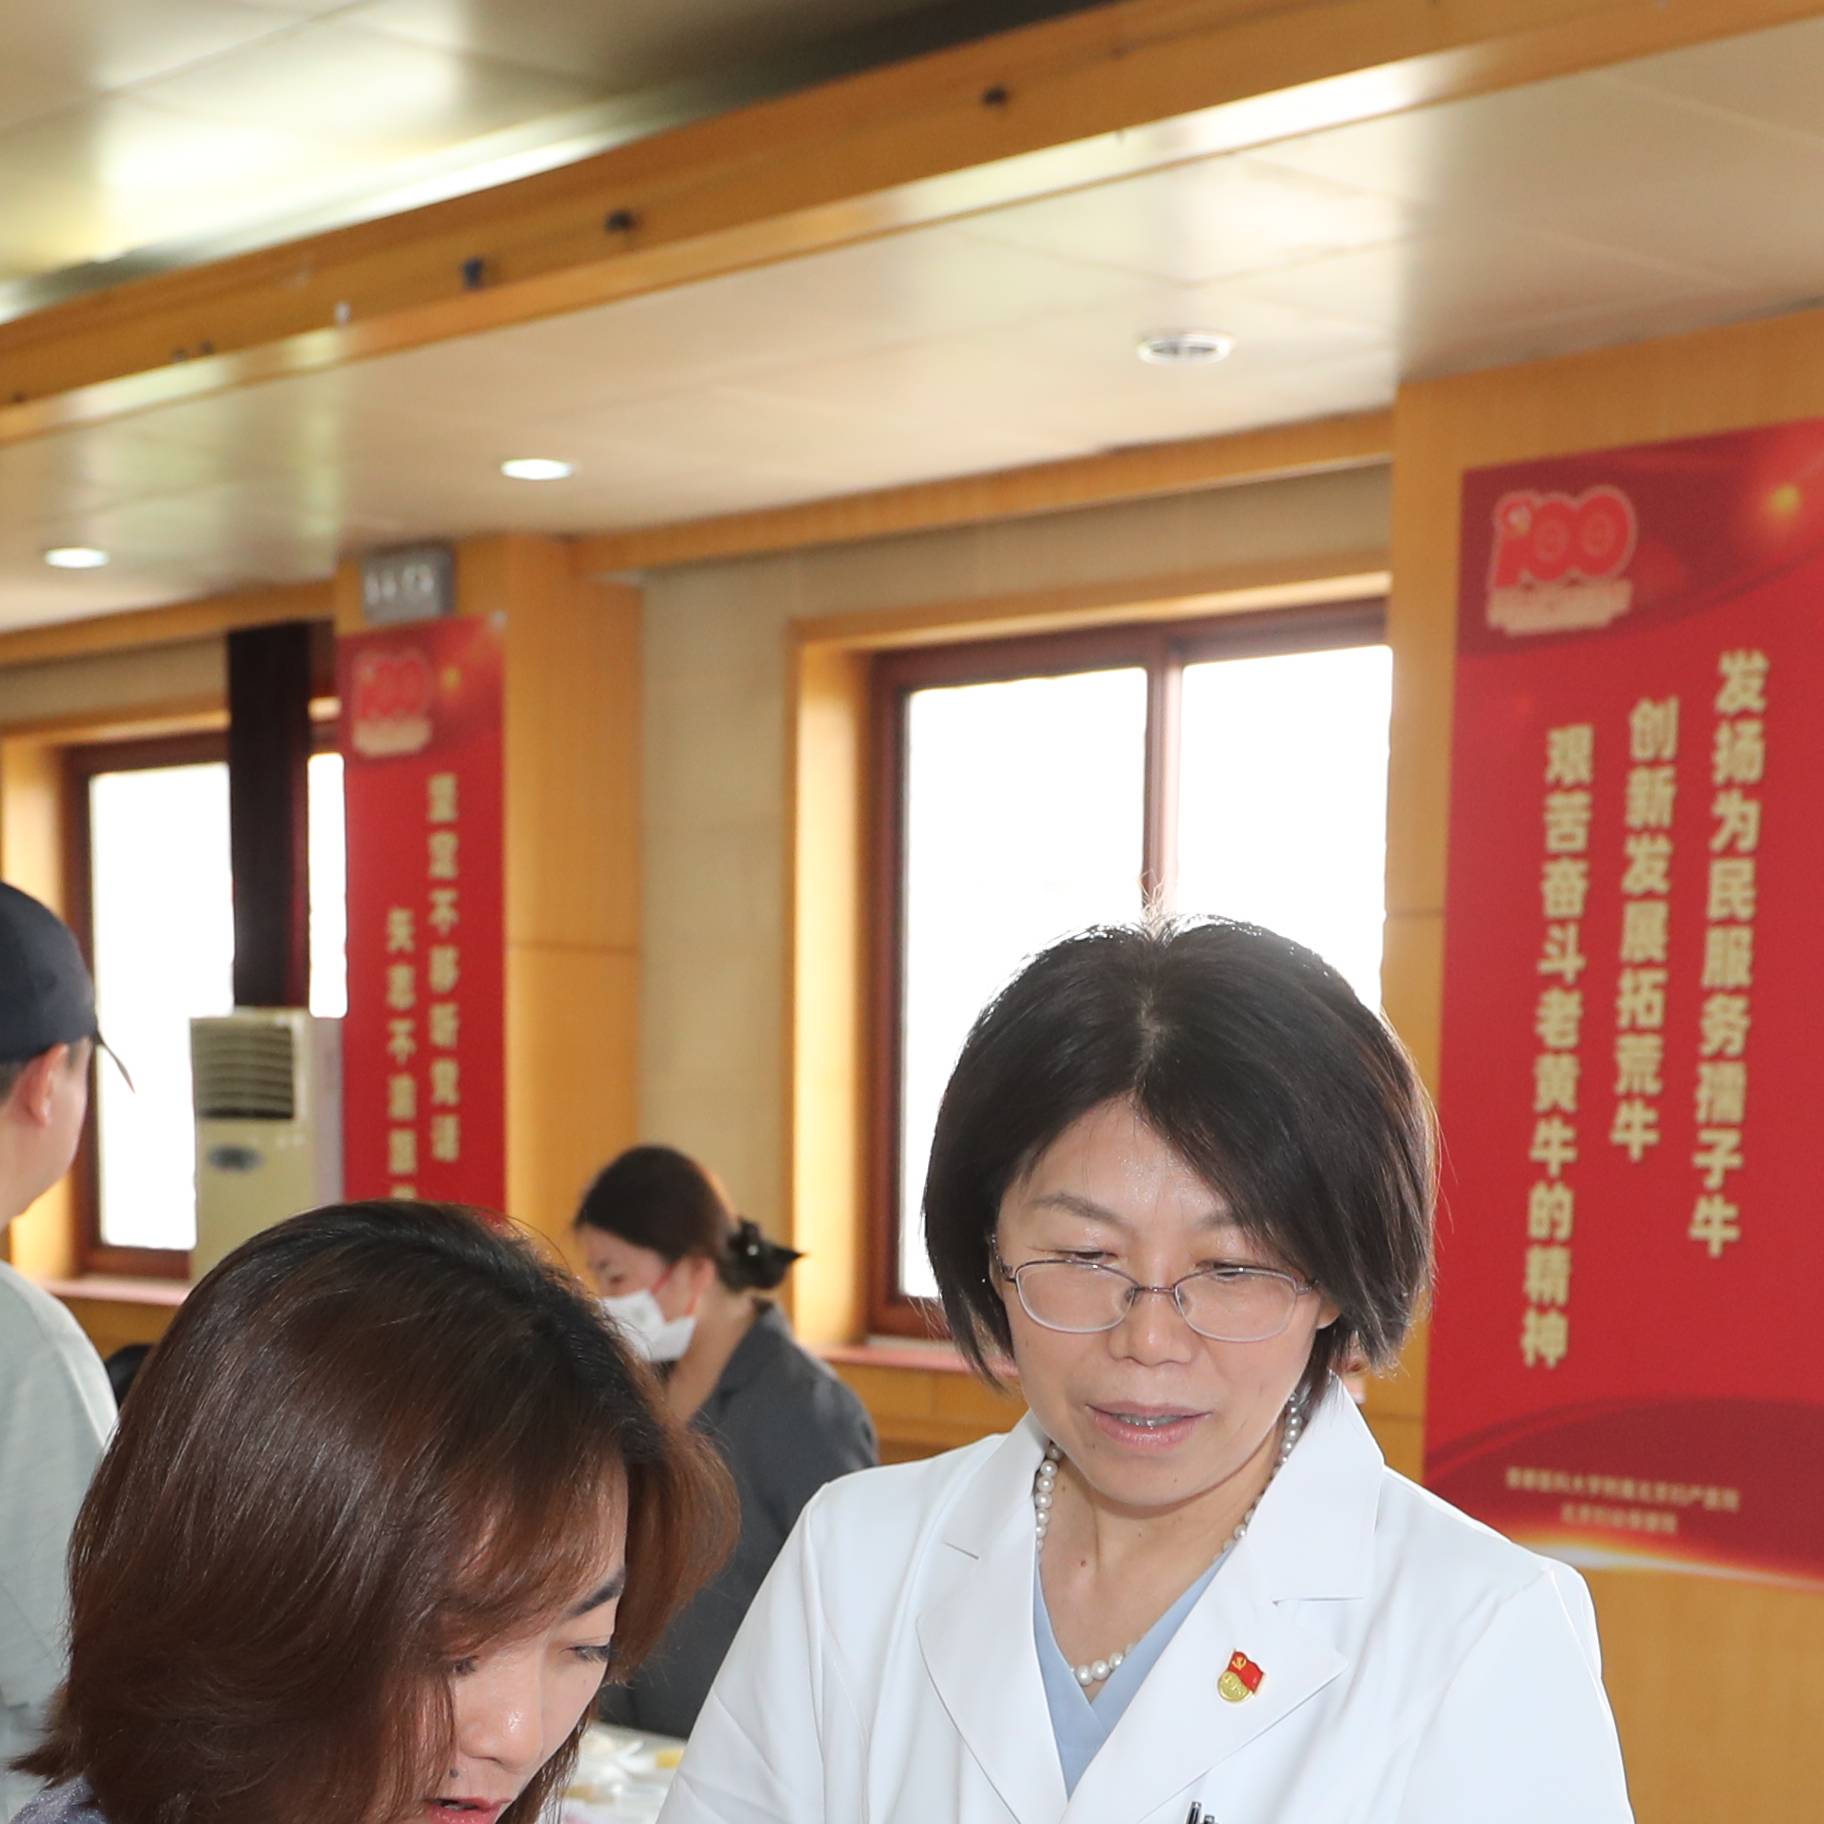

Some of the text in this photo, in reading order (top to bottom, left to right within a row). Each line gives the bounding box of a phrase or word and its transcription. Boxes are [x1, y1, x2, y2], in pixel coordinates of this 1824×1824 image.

[1519, 724, 1594, 1369] 艰苦奋斗老黄牛的精神
[1609, 695, 1680, 1162] 创新发展拓荒牛
[1688, 649, 1769, 1259] 发扬为民服务孺子牛
